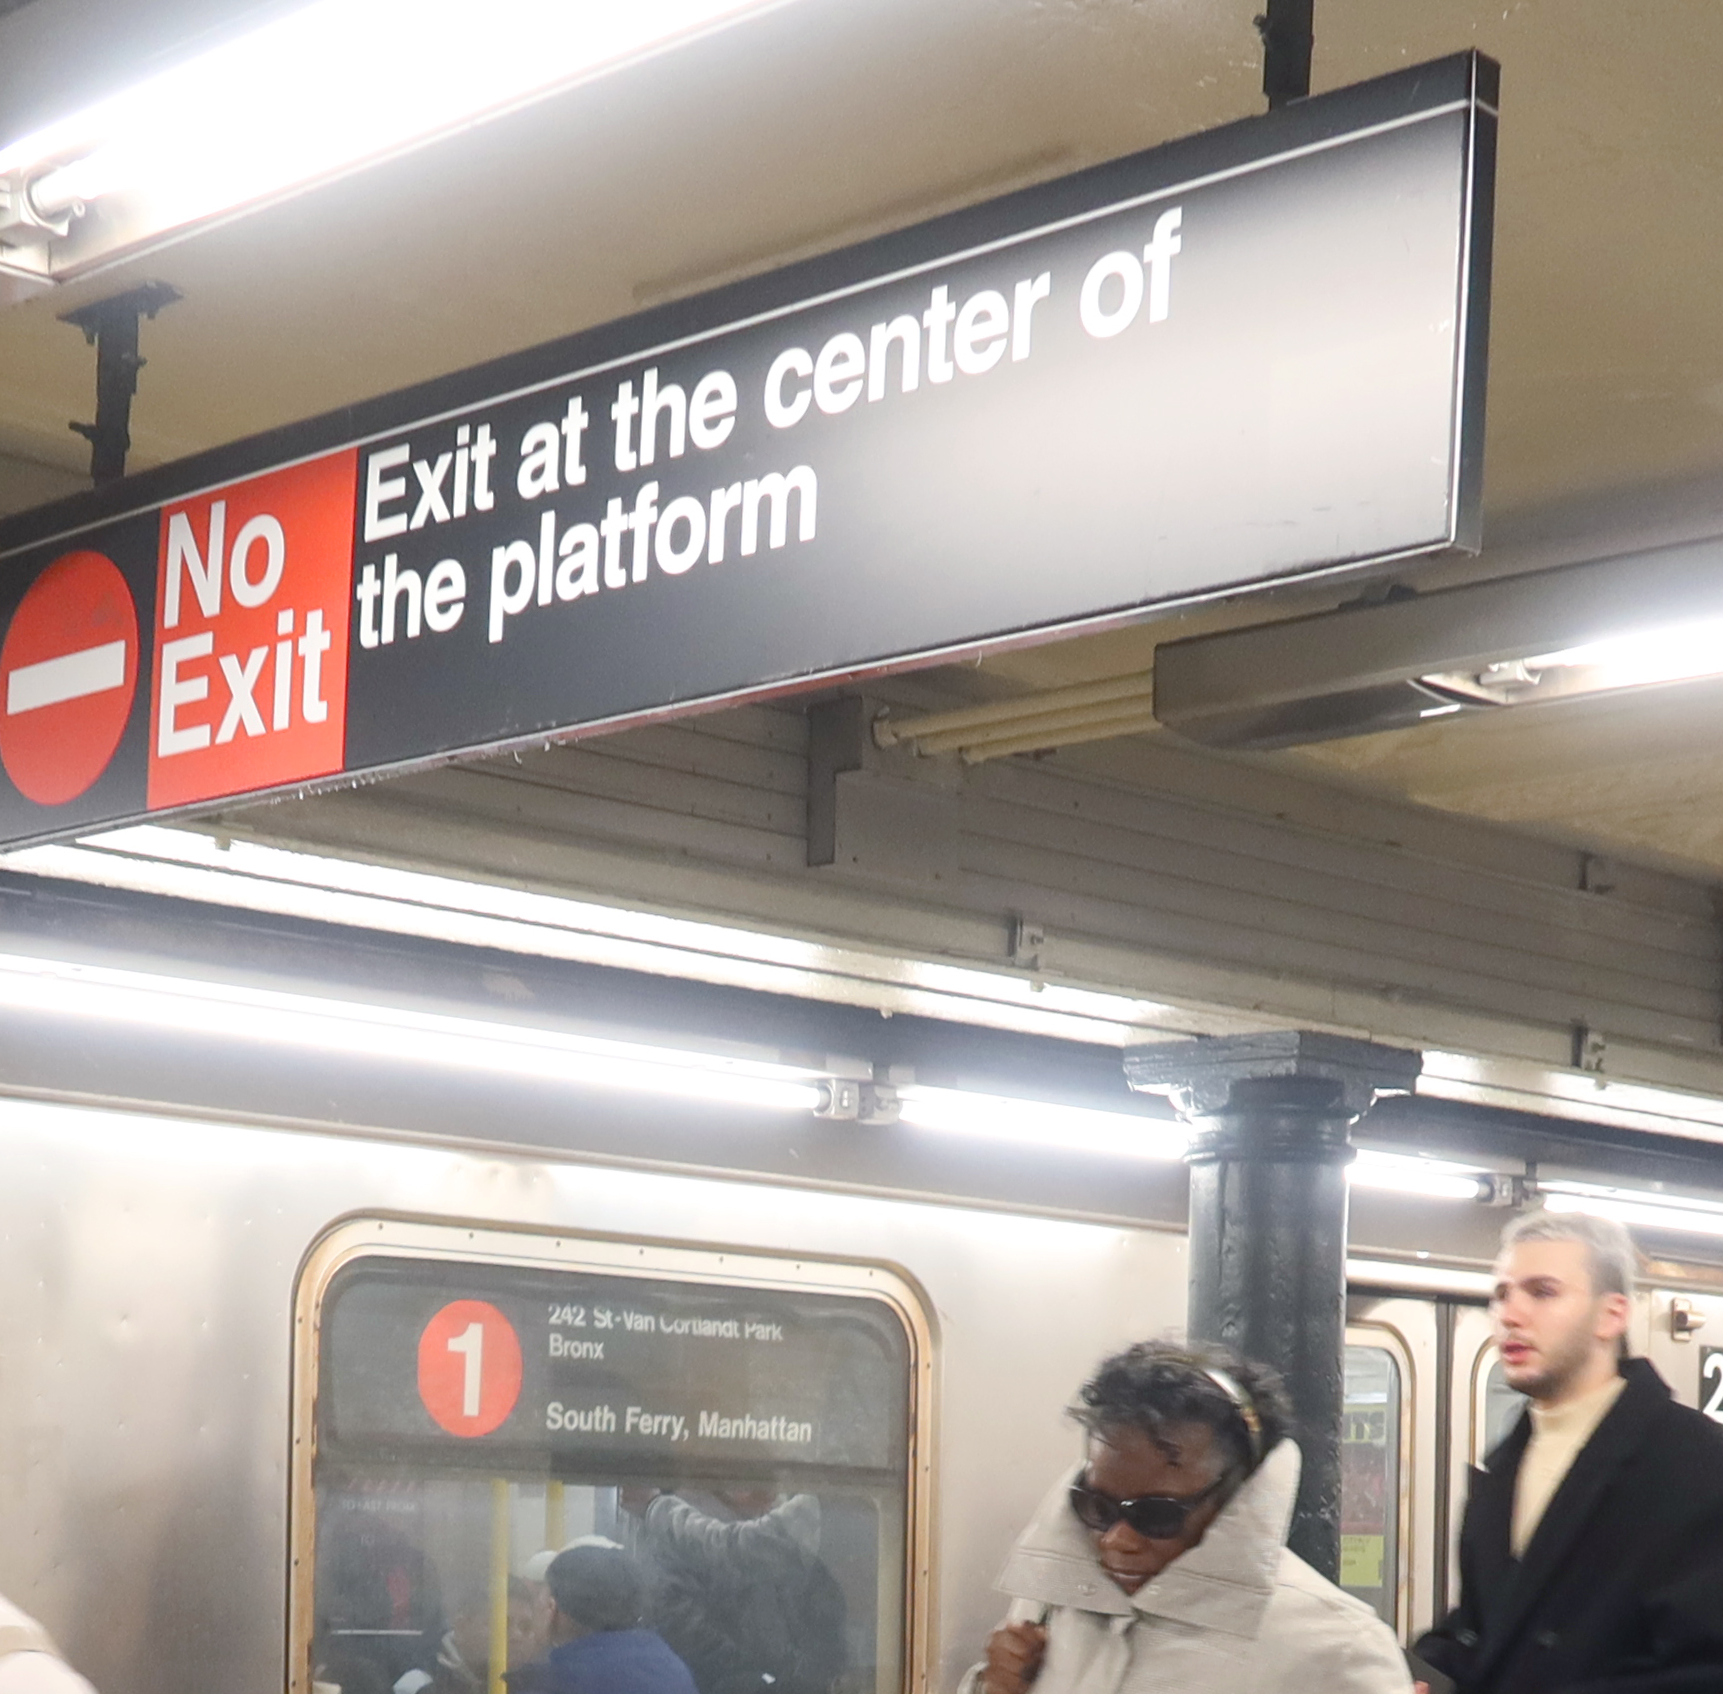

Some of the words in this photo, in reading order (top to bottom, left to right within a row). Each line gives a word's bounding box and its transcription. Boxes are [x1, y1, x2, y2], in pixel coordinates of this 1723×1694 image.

[364, 423, 496, 542] Exit
[517, 396, 588, 499] at
[611, 367, 737, 471] the
[763, 271, 1050, 429] center
[1079, 206, 1182, 338] of
[164, 500, 285, 629] No
[356, 553, 466, 649] the
[489, 464, 817, 643] platform
[158, 608, 331, 758] Exit
[447, 1322, 484, 1417] 1
[548, 1303, 587, 1327] 242
[548, 1333, 605, 1360] Bronx
[546, 1401, 616, 1433] South
[624, 1406, 689, 1442] Ferry,
[697, 1409, 812, 1443] Manhattan
